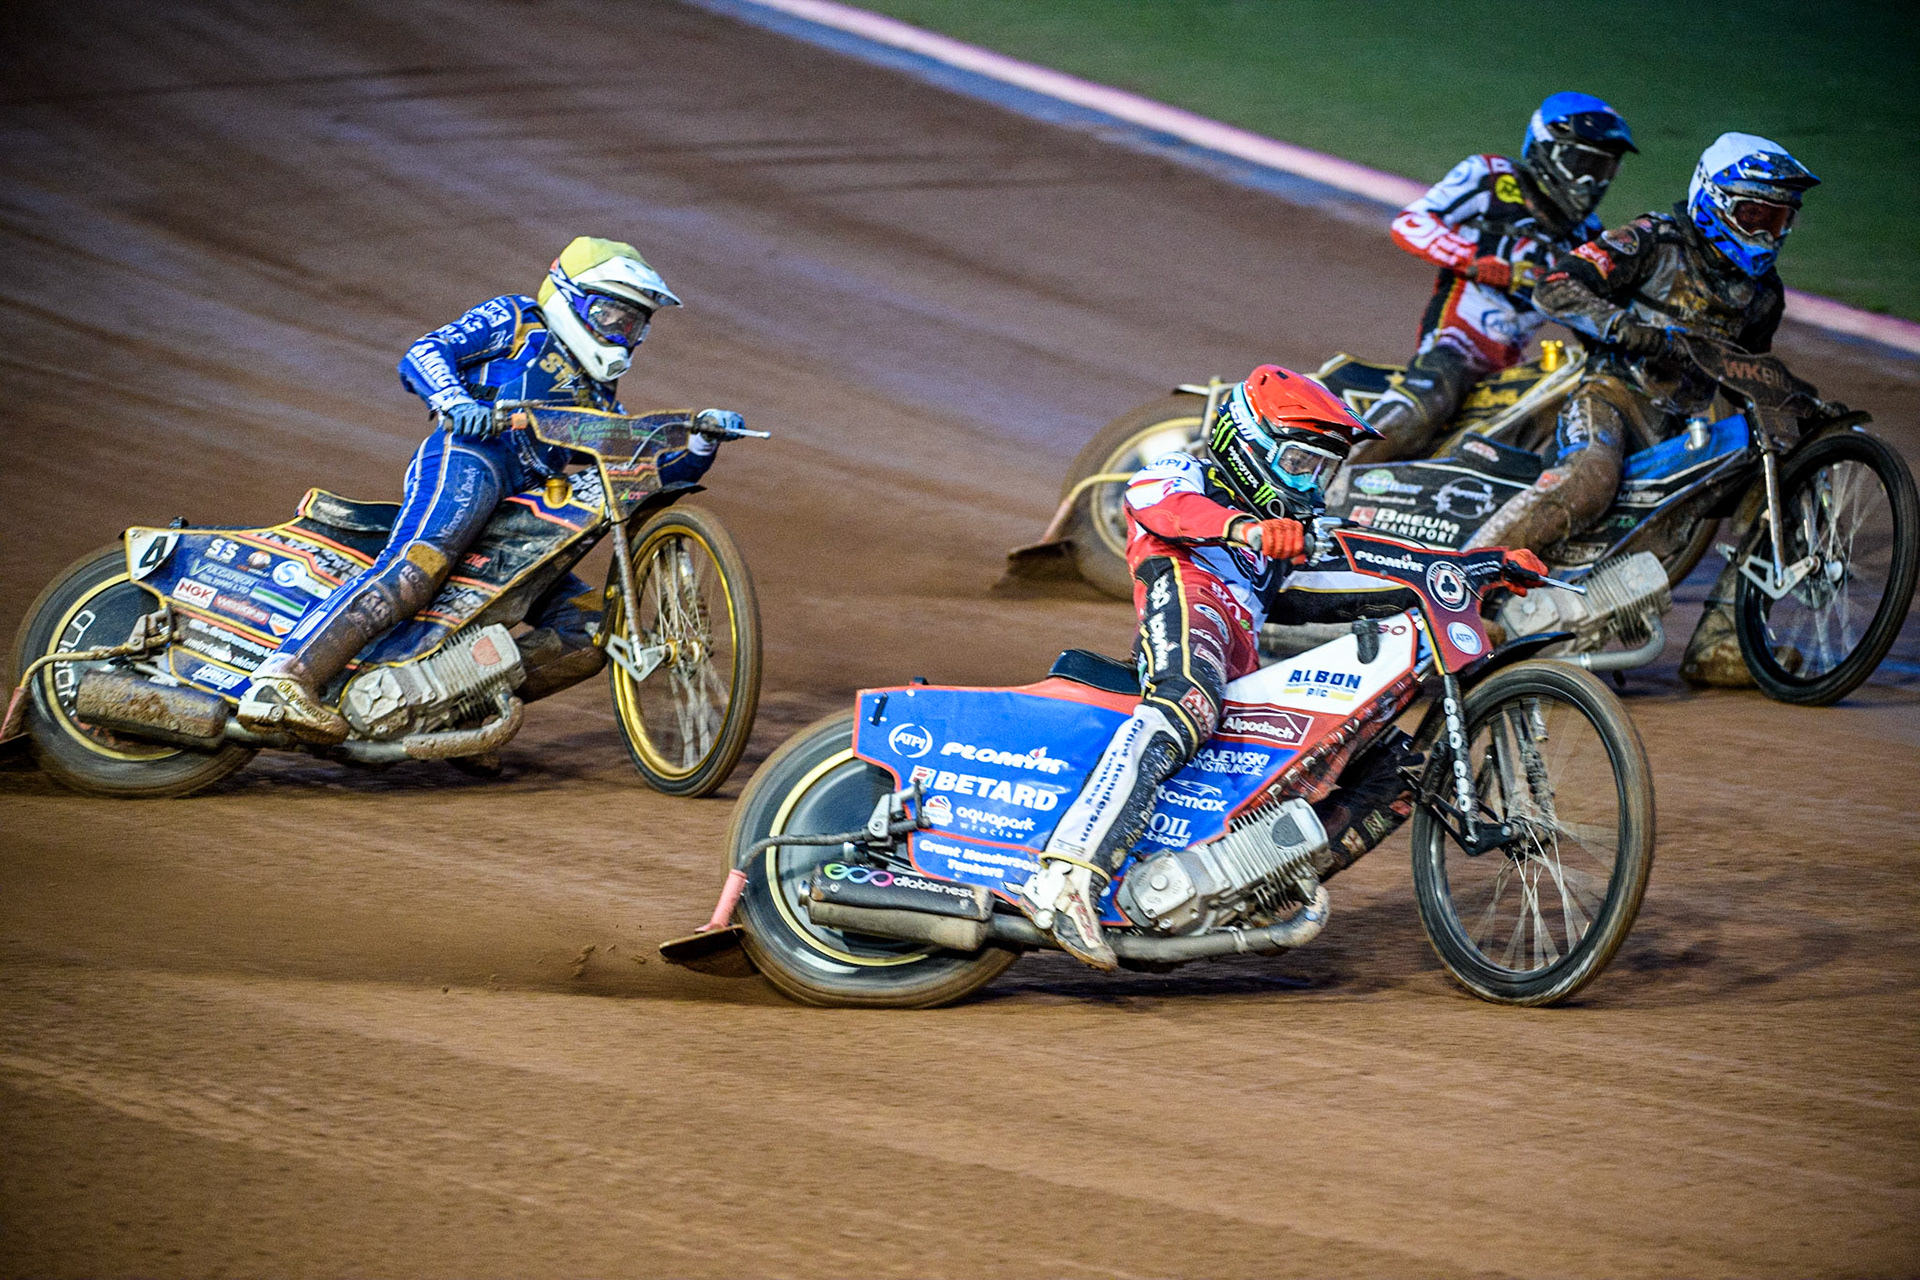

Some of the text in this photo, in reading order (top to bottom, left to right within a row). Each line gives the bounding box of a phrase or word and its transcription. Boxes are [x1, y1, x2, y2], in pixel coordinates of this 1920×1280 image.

[1372, 520, 1455, 543] TRANSPORT
[1375, 507, 1460, 535] BREUM
[139, 535, 168, 569] 4
[178, 582, 213, 599] NGK
[1288, 669, 1362, 689] ALBON
[895, 730, 926, 750] ATPI
[1222, 717, 1296, 741] Alpodach
[933, 771, 1059, 812] BETARD
[1080, 763, 1126, 842] Henderson
[956, 806, 1037, 833] aquapark
[1150, 812, 1193, 839] OIL
[919, 839, 1042, 873] Grant Henderson
[947, 859, 1005, 879] Tankers
